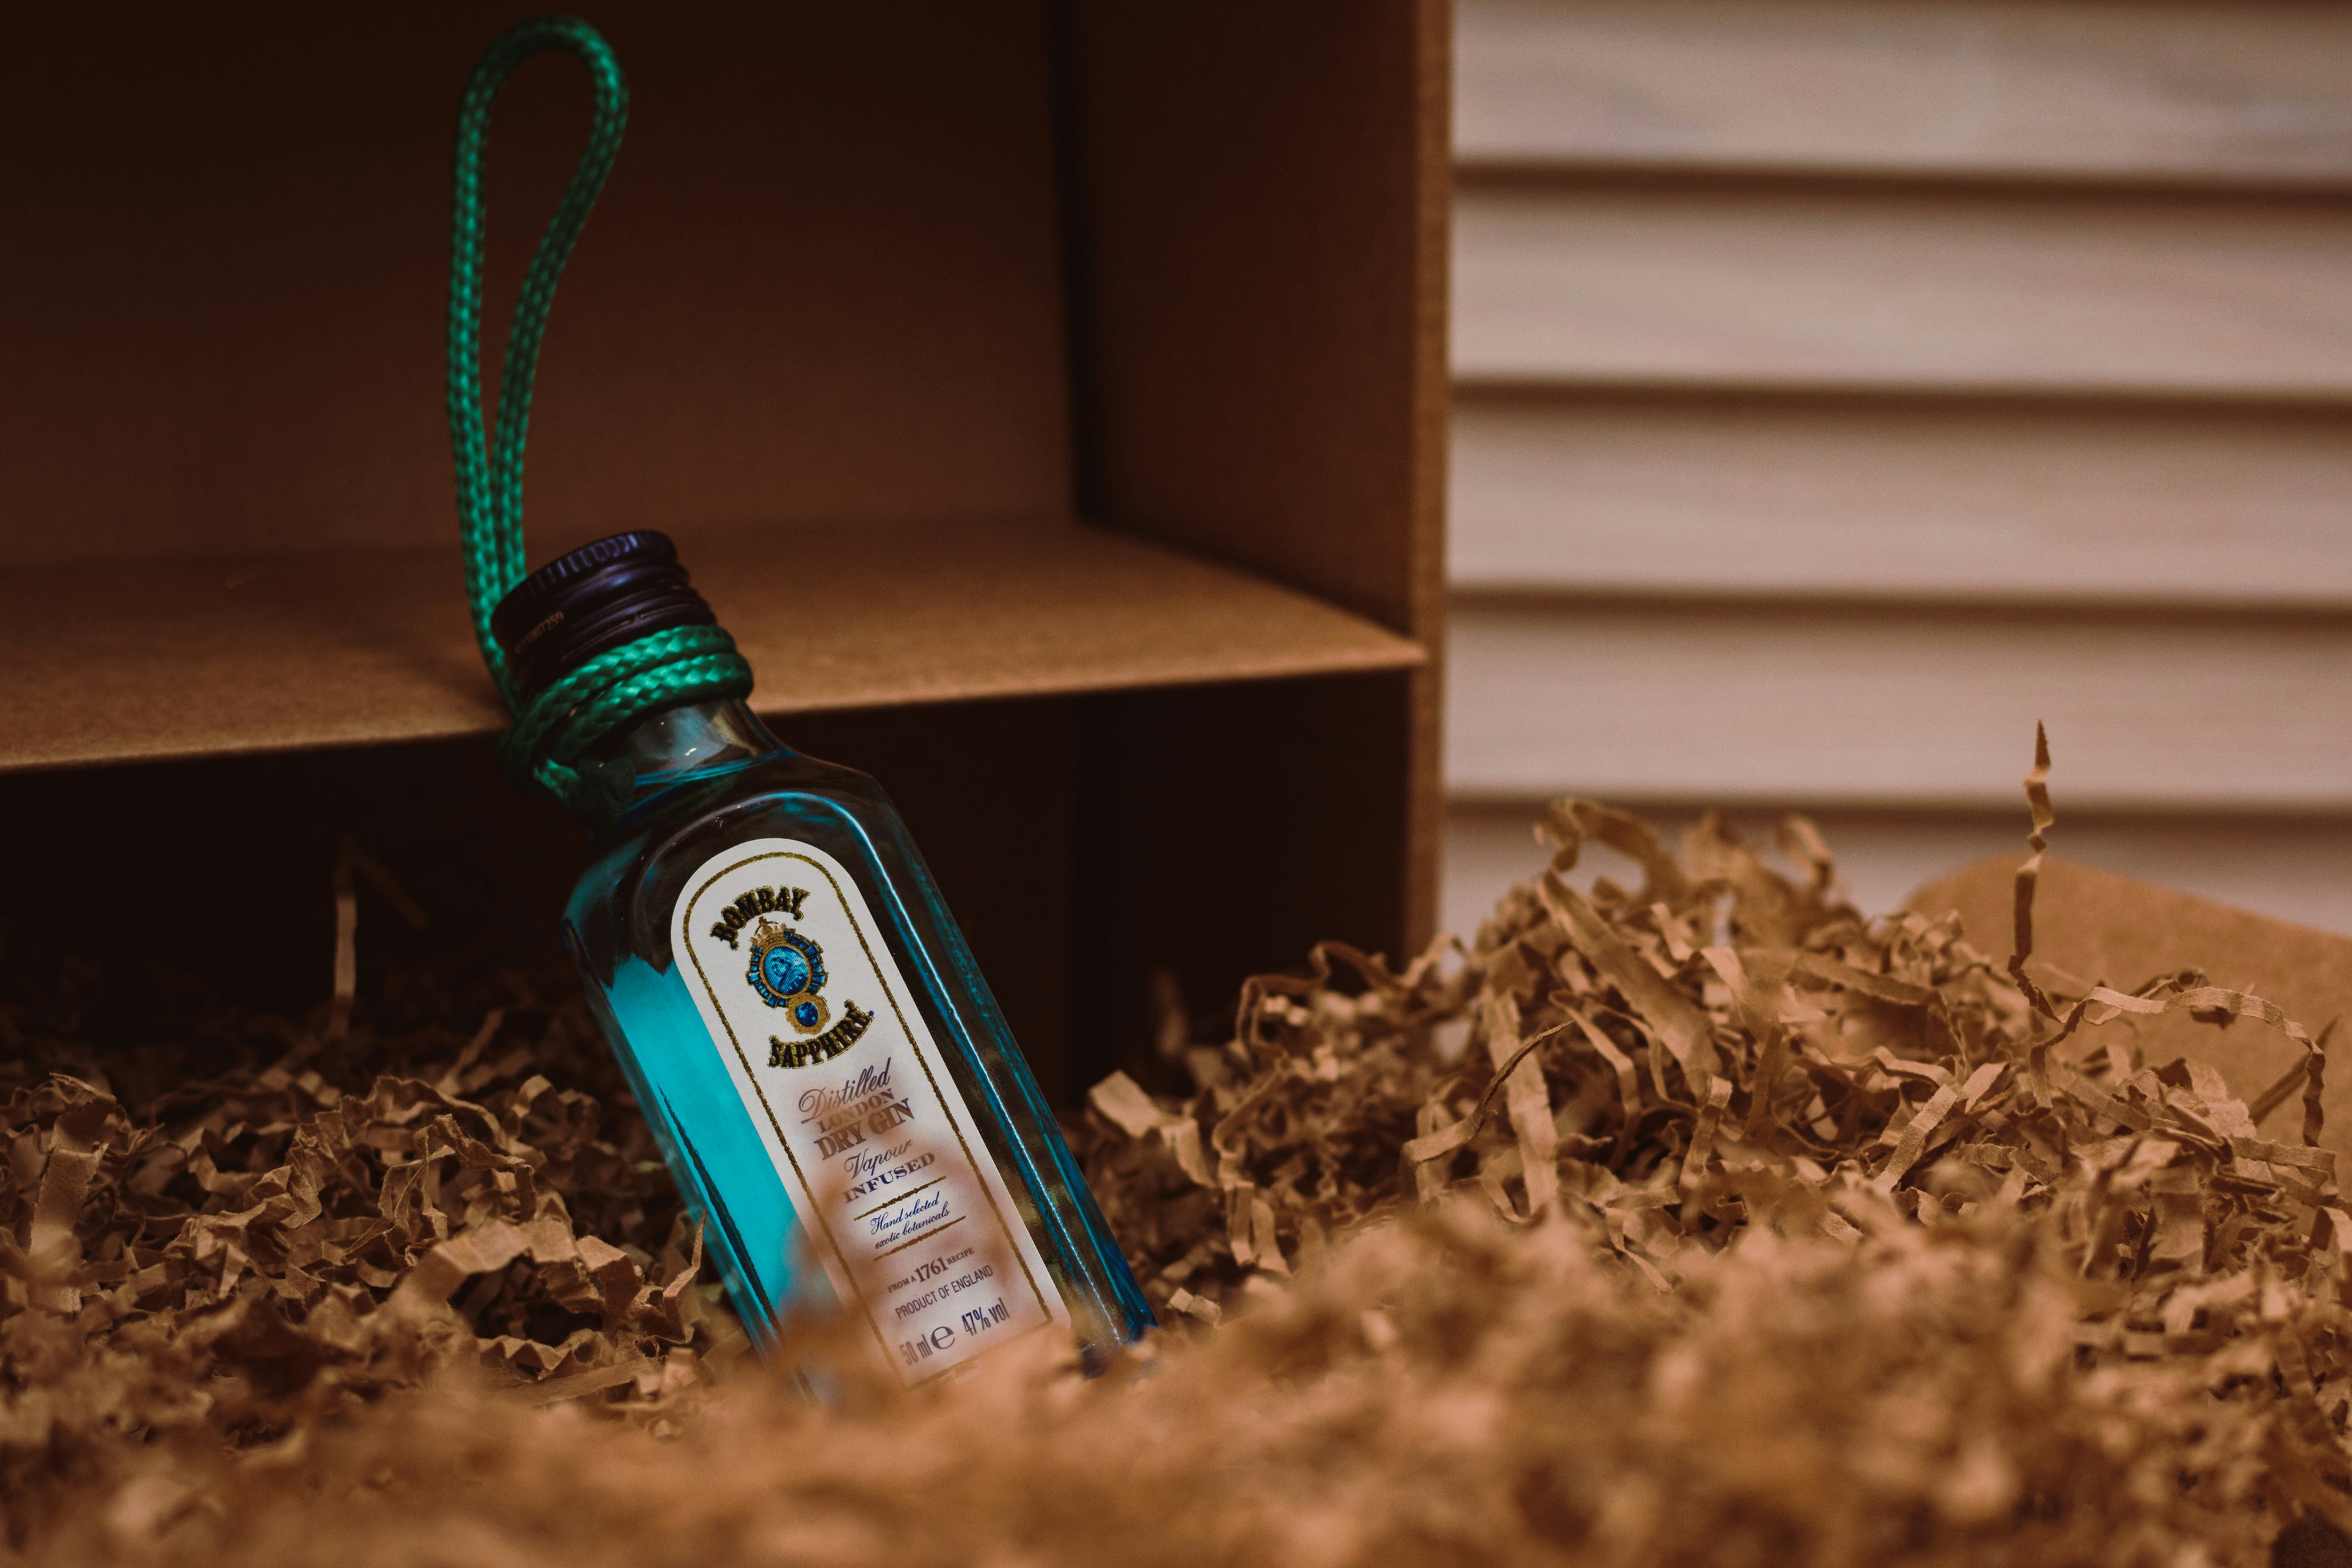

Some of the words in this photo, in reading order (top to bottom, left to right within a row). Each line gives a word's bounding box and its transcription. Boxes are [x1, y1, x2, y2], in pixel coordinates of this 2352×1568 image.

[709, 885, 811, 951] BOMBAY
[799, 1057, 892, 1124] Distilled
[816, 1088, 894, 1133] LONDON
[814, 1120, 867, 1161] DRY
[872, 1097, 915, 1135] GIN
[841, 1152, 935, 1203] INFUSED
[844, 1139, 913, 1180] Vapour
[870, 1209, 903, 1235] Hand
[904, 1191, 940, 1222] selected
[875, 1231, 901, 1250] exotic
[903, 1201, 950, 1235] botanicals
[887, 1279, 910, 1294] FROM
[914, 1257, 949, 1283] 1761
[946, 1247, 975, 1264] RECIPE
[894, 1291, 937, 1320] PRODUCT
[938, 1286, 950, 1300] OF
[952, 1264, 994, 1293] ENGLAND
[898, 1341, 918, 1366] 50
[914, 1333, 933, 1359] ml
[960, 1307, 992, 1336] 47%
[988, 1297, 1011, 1325] vol
